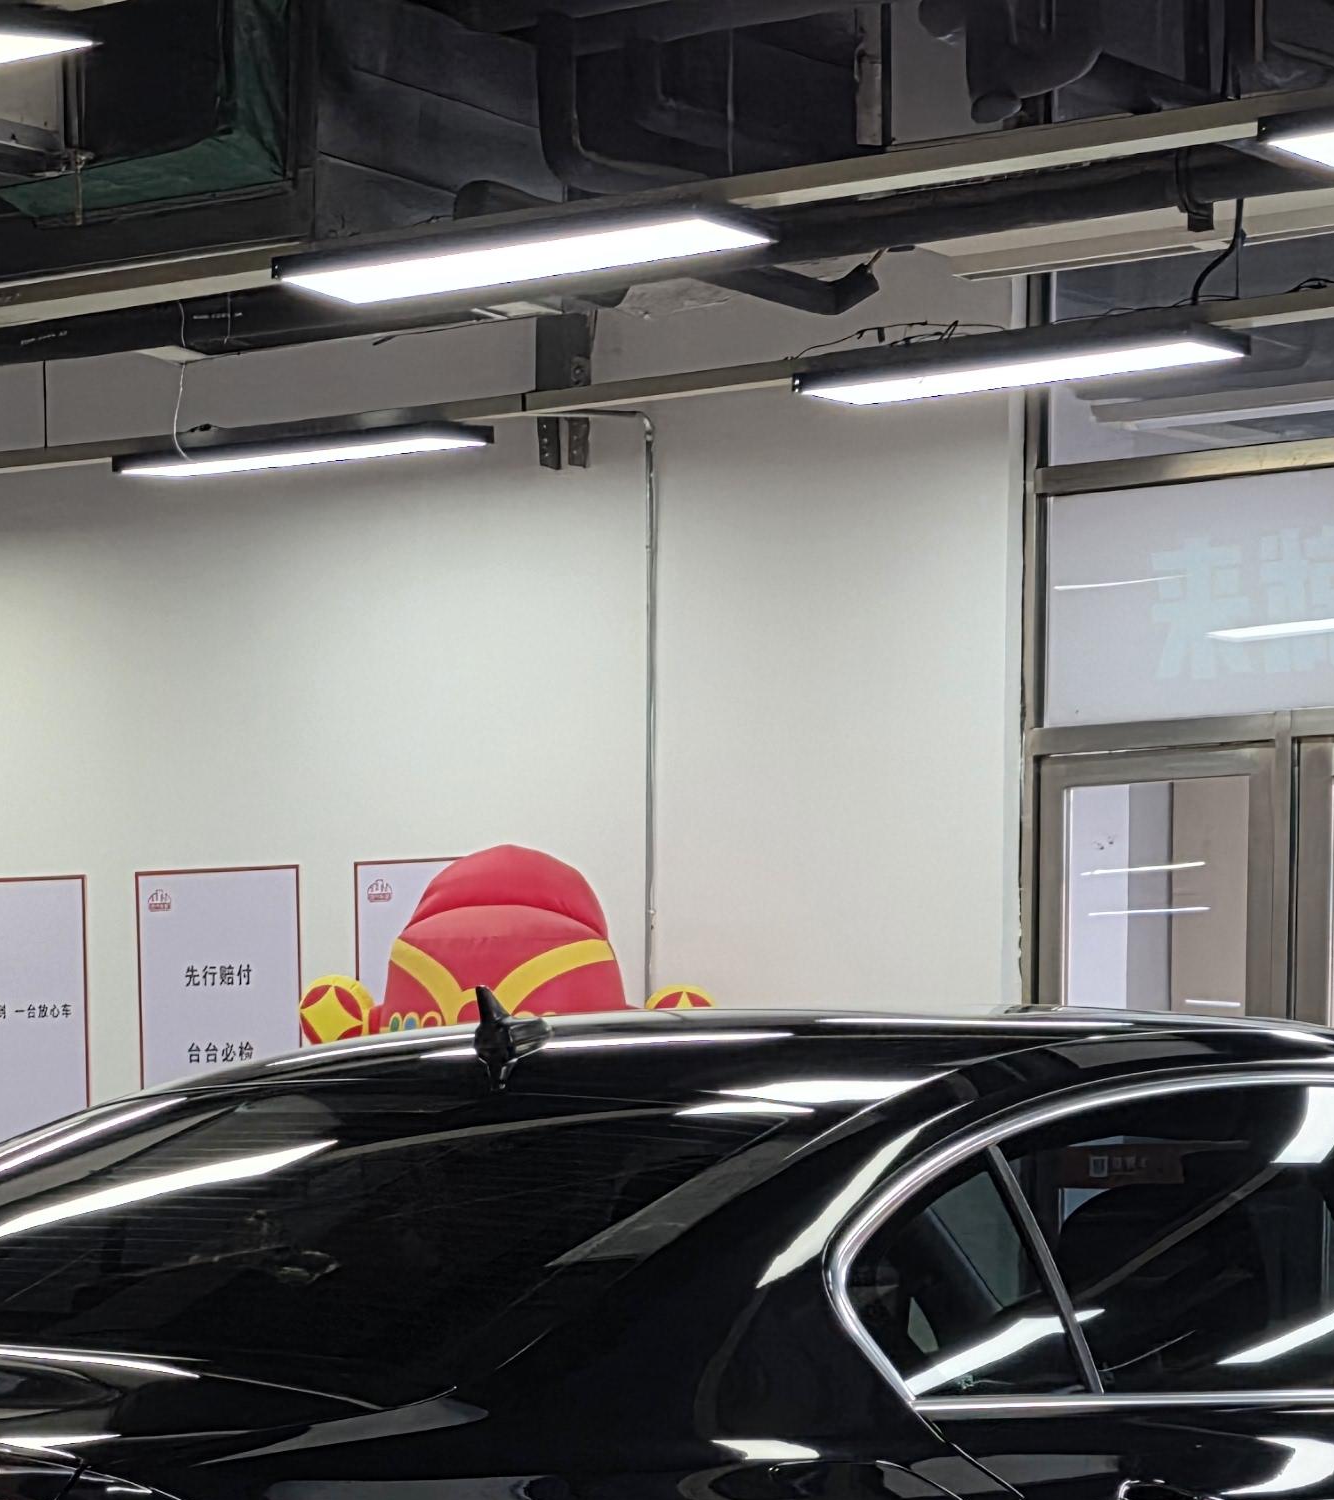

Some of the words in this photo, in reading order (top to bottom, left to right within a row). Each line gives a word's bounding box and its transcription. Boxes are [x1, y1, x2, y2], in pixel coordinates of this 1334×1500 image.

[184, 964, 253, 987] 先行赔付
[14, 1003, 72, 1018] 一台放心车
[187, 1041, 254, 1064] 台台必检
